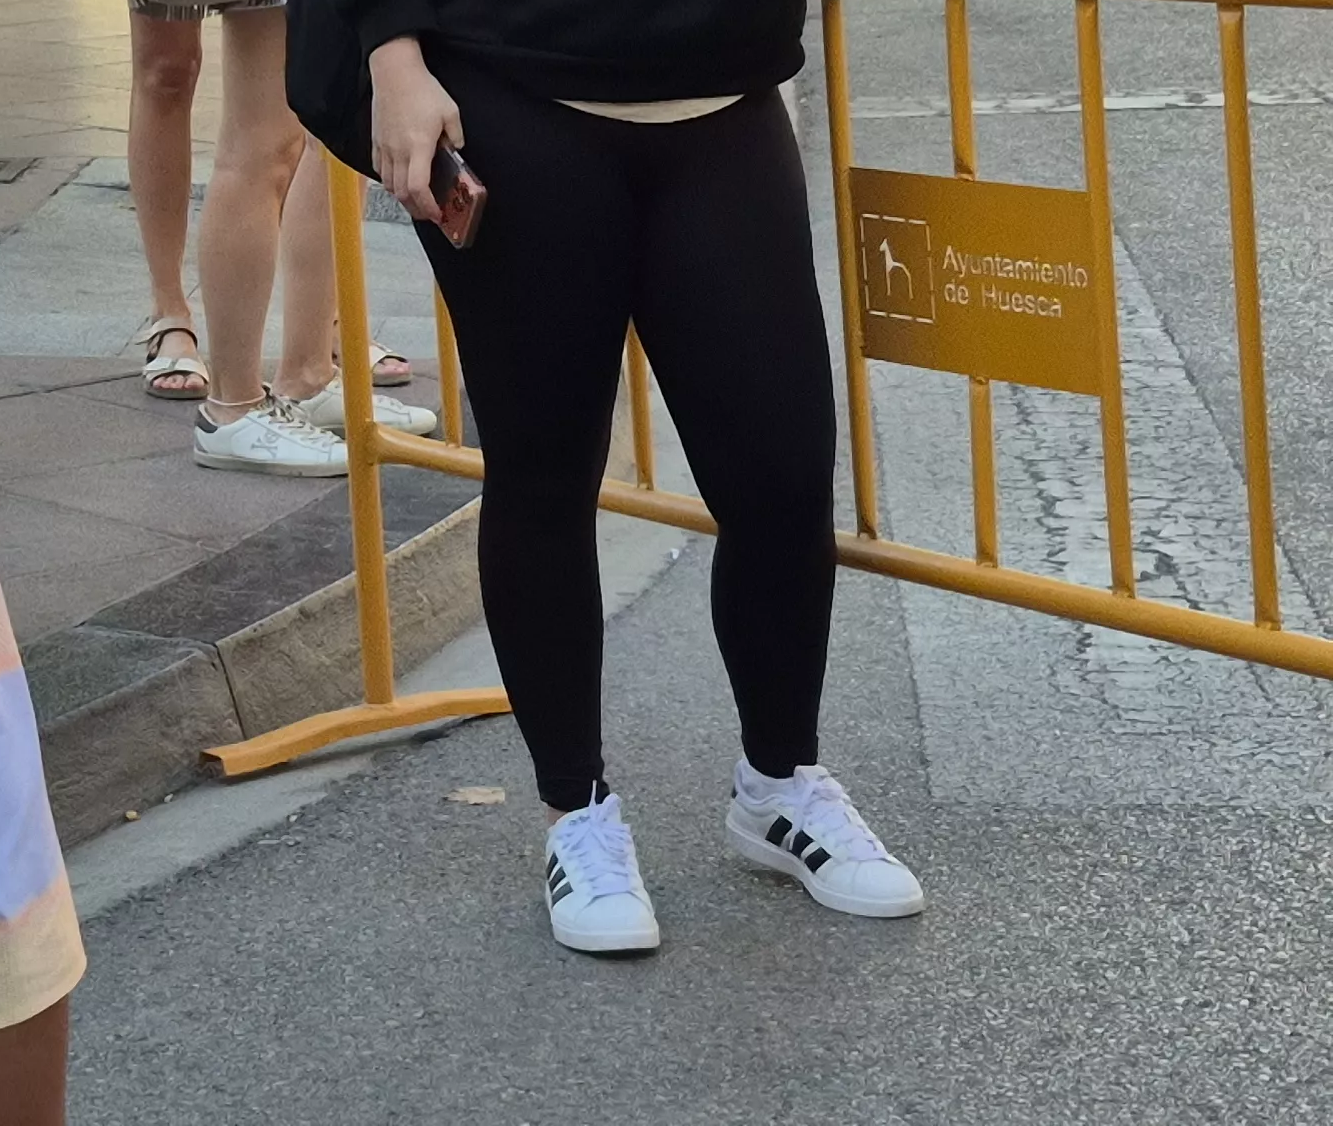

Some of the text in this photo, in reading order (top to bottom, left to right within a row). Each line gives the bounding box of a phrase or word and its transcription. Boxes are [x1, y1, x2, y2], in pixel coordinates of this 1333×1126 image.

[943, 245, 1088, 288] Ayuntamiento
[944, 279, 1062, 318] de Huesca
